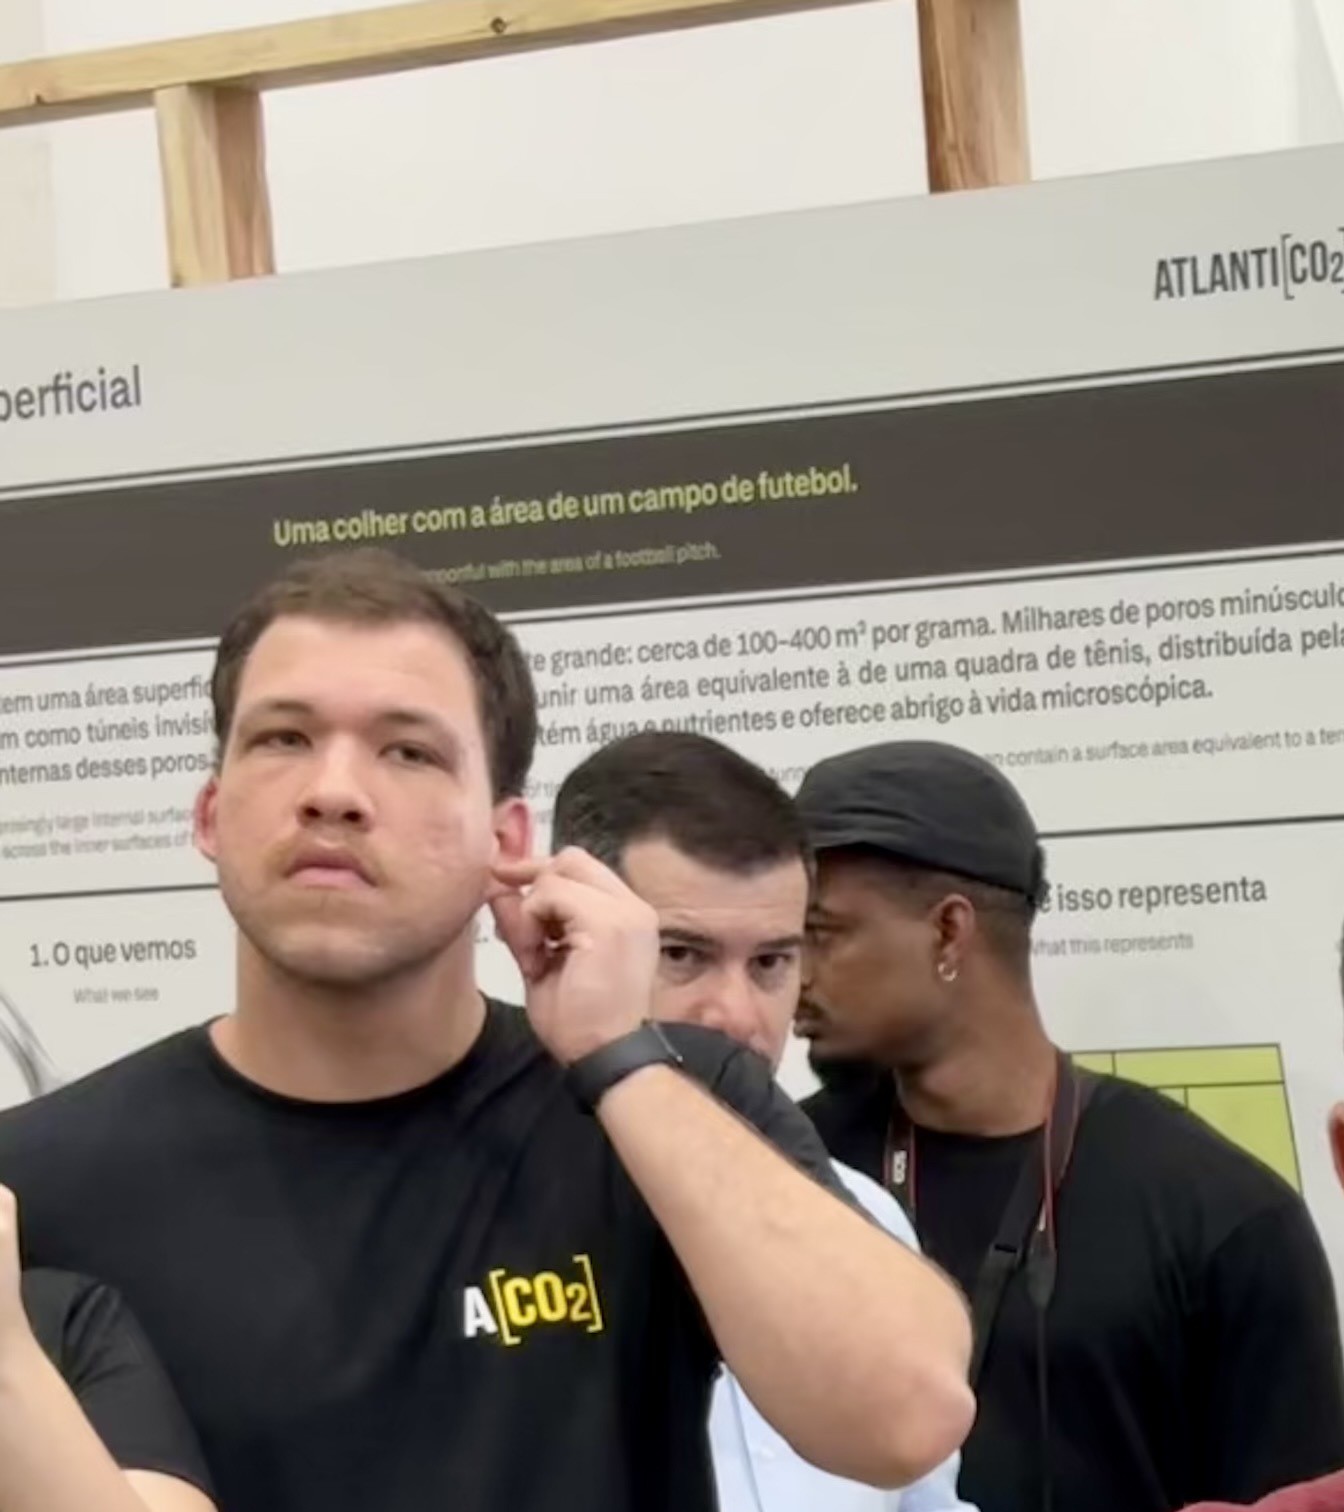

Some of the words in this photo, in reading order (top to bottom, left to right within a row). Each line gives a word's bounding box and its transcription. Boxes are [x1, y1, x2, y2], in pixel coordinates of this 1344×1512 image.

[272, 517, 331, 547] Uma
[332, 508, 409, 542] colher
[411, 503, 467, 533] com
[470, 504, 488, 528] a
[489, 495, 546, 526] área
[546, 490, 580, 520] de
[583, 489, 626, 518] um
[627, 481, 719, 514] campo
[720, 475, 756, 504] de
[757, 462, 859, 500] futebol.
[0, 694, 34, 715] em
[37, 690, 82, 712] uma
[85, 682, 130, 707] área
[550, 642, 633, 677] grande:
[637, 639, 700, 664] cerca
[702, 633, 732, 658] de
[872, 623, 911, 650] por
[914, 615, 997, 649] grama.
[1002, 605, 1105, 634] Milhares
[1109, 599, 1141, 625] de
[1145, 596, 1216, 629] poros
[24, 727, 82, 750] como
[86, 717, 149, 744] túneis
[584, 683, 635, 707] uma
[640, 674, 690, 700] área
[697, 664, 830, 702] equivalente
[836, 660, 851, 687] à
[858, 658, 888, 686] de
[895, 658, 948, 682] uma
[954, 648, 1039, 681] quadra
[1046, 643, 1078, 670] de
[1084, 637, 1152, 667] tênis,
[1158, 626, 1293, 662] distribuída
[76, 756, 148, 780] desses
[662, 707, 778, 736] nutrientes
[781, 709, 796, 729] e
[799, 701, 886, 728] oferece
[890, 692, 965, 724] abrigo
[968, 689, 983, 716] à
[986, 686, 1037, 715] vida
[1042, 673, 1213, 711] microscópica.
[1191, 730, 1282, 757] equivalent
[1284, 730, 1303, 748] to
[1057, 883, 1113, 912] isso
[1118, 875, 1268, 914] representa
[29, 944, 50, 968] 1.
[52, 940, 71, 967] O
[74, 940, 118, 971] que
[119, 937, 198, 963] vemos
